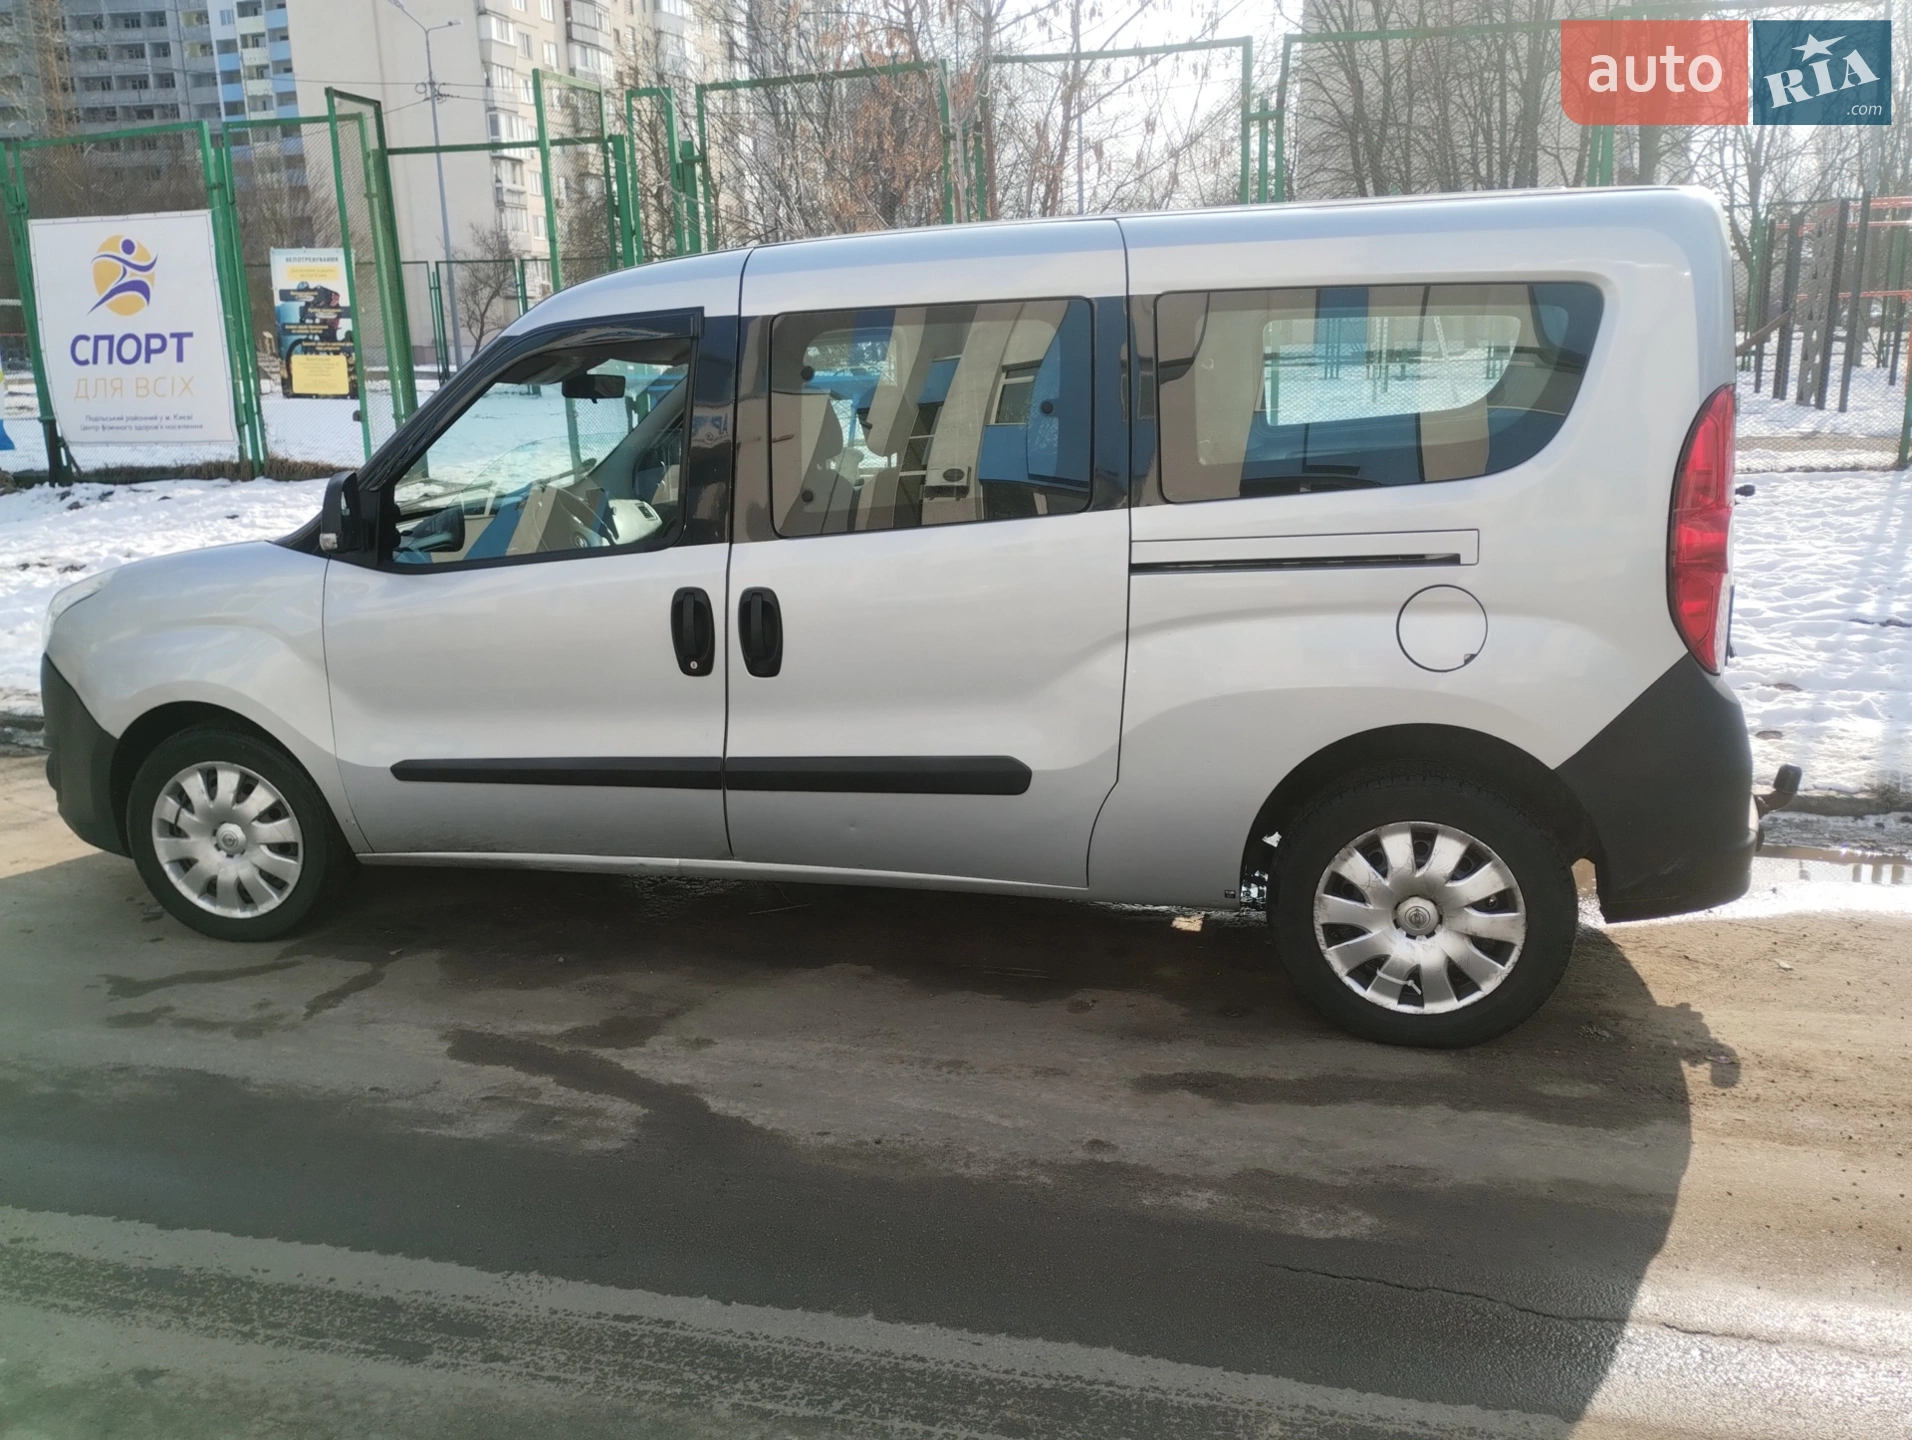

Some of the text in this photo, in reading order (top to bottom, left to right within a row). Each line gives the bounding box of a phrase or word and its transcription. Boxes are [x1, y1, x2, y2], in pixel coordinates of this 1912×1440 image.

[70, 332, 194, 366] СПОРТ
[74, 375, 196, 402] ДЛЯ ВСІХ
